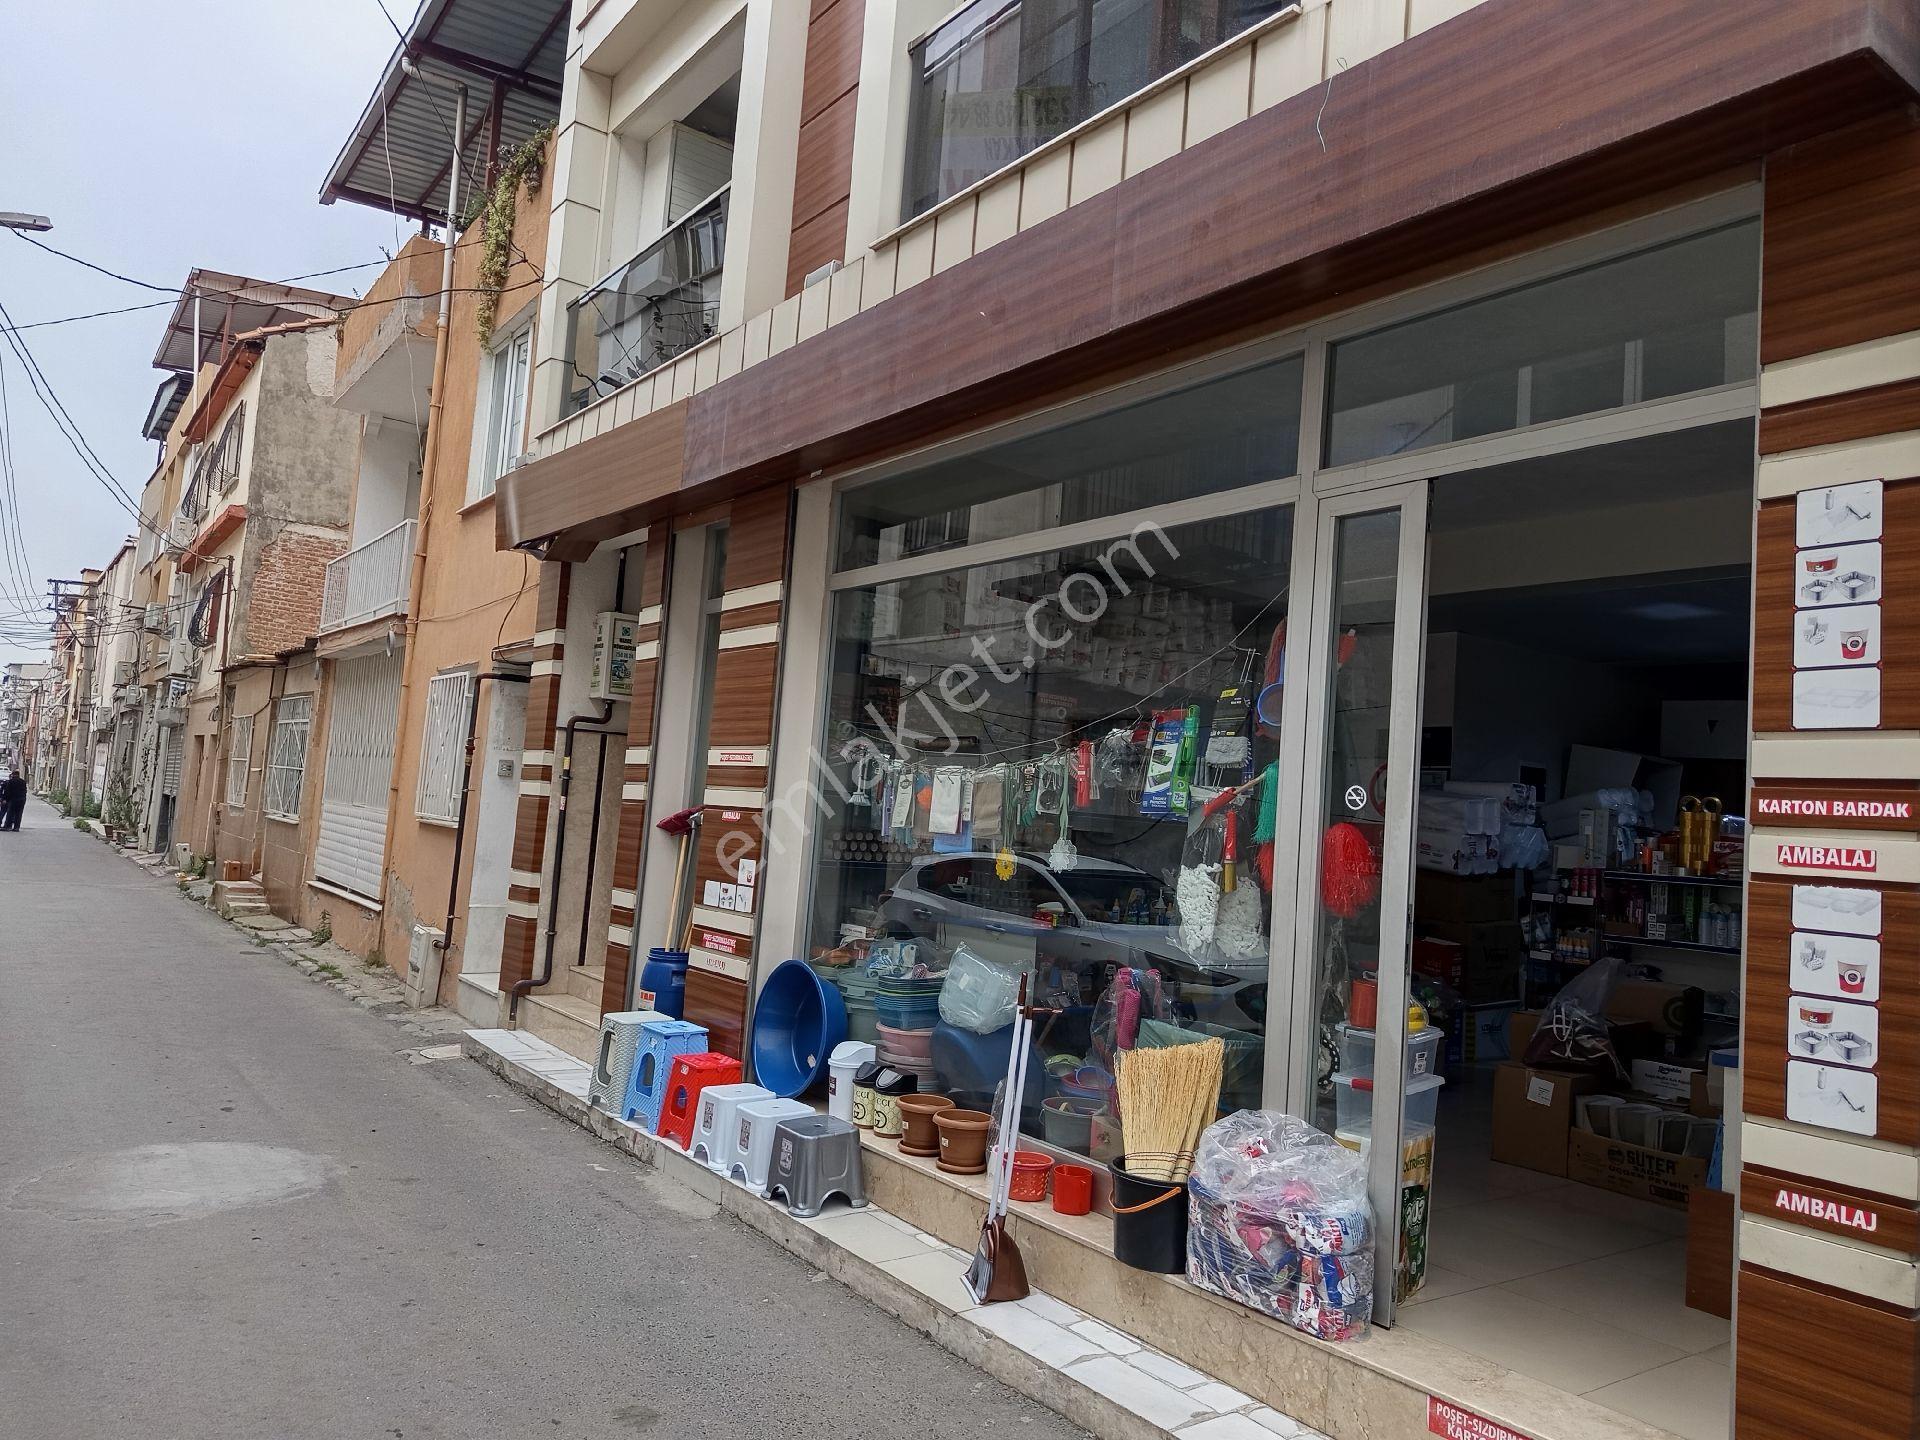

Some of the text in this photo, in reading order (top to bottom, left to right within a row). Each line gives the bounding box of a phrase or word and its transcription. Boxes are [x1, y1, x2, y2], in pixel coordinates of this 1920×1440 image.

[1758, 798, 1909, 818] KARTON BARDAK
[1778, 845, 1876, 868] AMBALAJ
[1775, 1189, 1877, 1232] AMBALAJ
